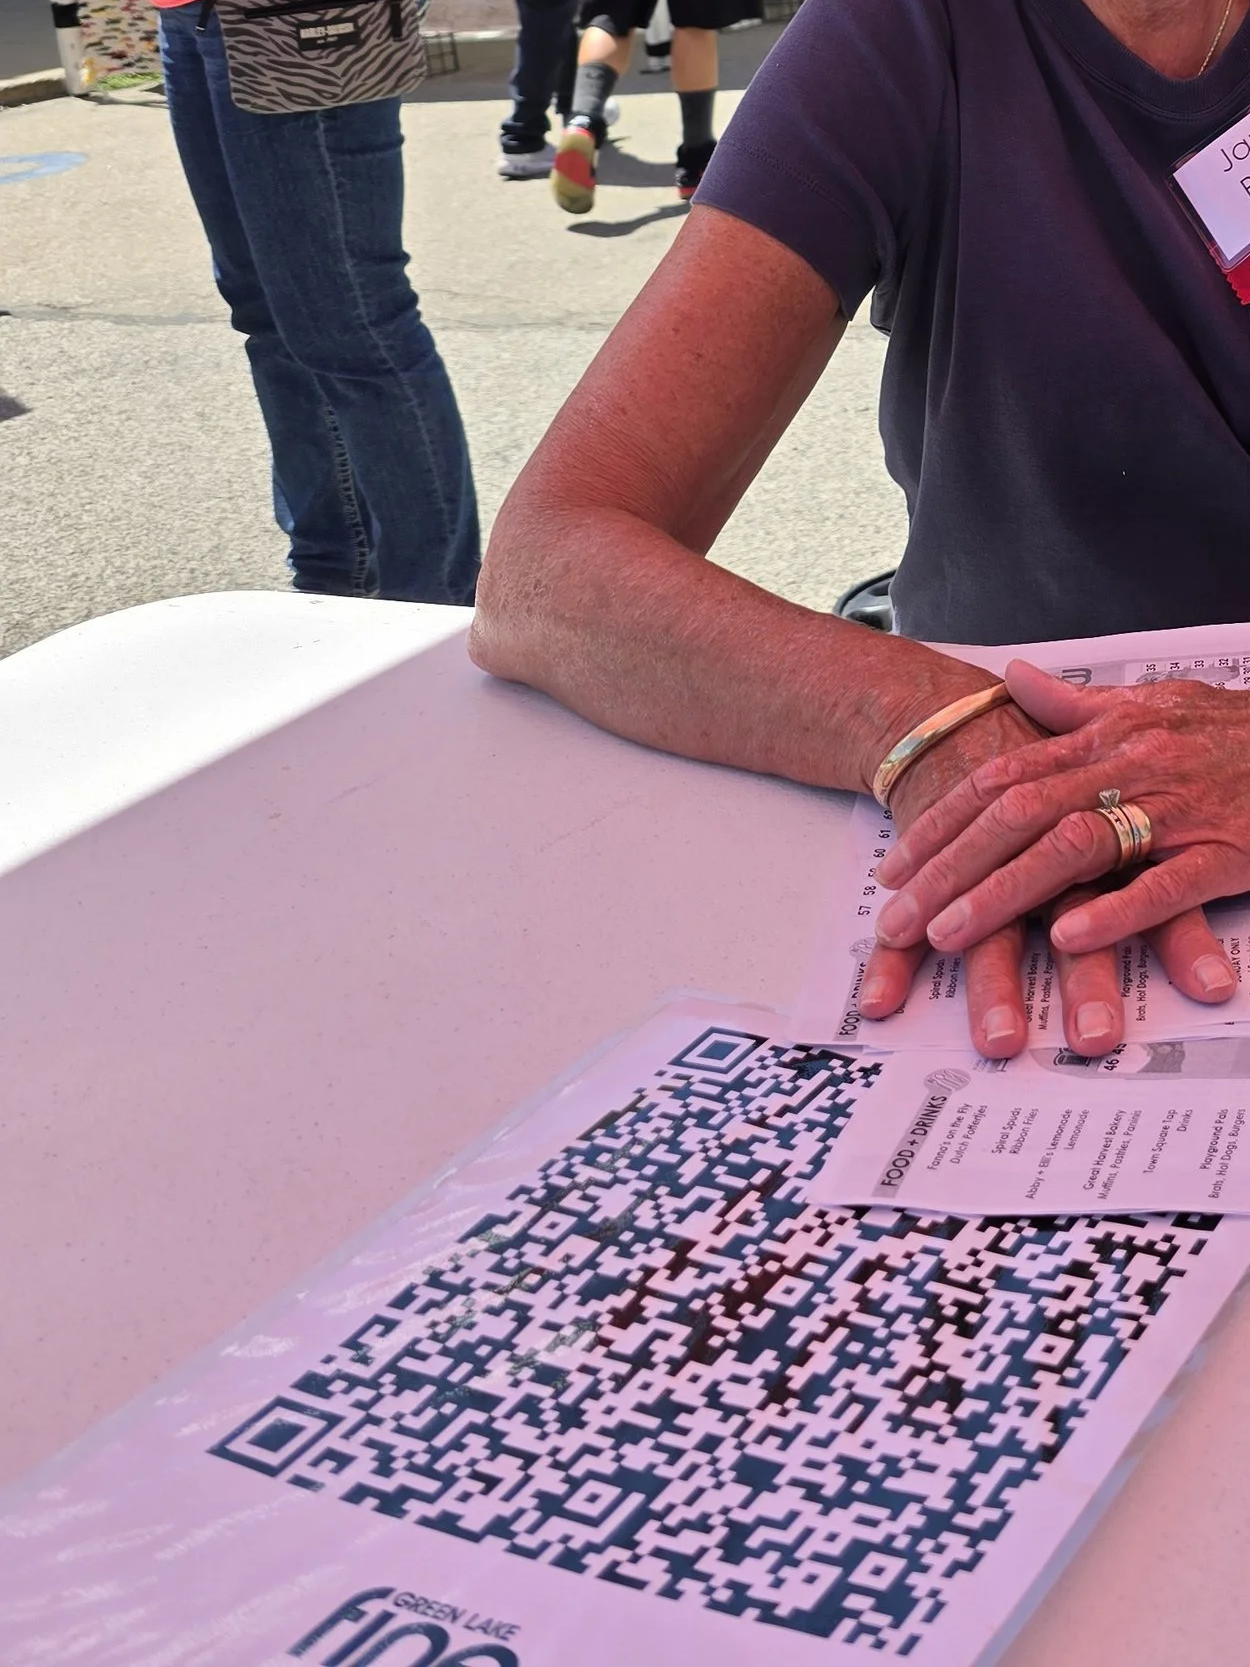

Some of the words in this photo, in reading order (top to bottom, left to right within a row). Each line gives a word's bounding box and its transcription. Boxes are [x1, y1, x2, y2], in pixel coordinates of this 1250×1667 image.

[1145, 663, 1157, 672] 35
[1169, 662, 1181, 670] 34
[1194, 660, 1205, 668] 33
[1218, 658, 1229, 666] 32
[883, 809, 893, 820] 62
[878, 829, 891, 839] 61
[873, 848, 886, 858] 60
[863, 885, 877, 896] 58
[857, 905, 872, 915] 57
[1137, 944, 1150, 968] Burgers
[1230, 937, 1240, 955] ONLY
[932, 958, 946, 980] Spuds
[949, 957, 961, 973] Fries
[1027, 953, 1041, 976] Bakery
[945, 973, 958, 998] Ribbon
[1040, 975, 1053, 1003] Pastries,
[1121, 960, 1133, 997] Playground
[1136, 969, 1149, 989] Dogs,
[928, 980, 942, 1000] Spiral
[1025, 977, 1036, 1003] Harvest
[1136, 990, 1146, 1002] Hot
[839, 1009, 861, 1036] FOOD
[1038, 1004, 1050, 1031] Muffins,
[1136, 1003, 1147, 1021] Brats,
[1103, 1059, 1120, 1071] 46
[957, 1103, 972, 1114] Fly
[1162, 1109, 1178, 1124] Tap
[949, 1116, 964, 1128] the
[991, 1131, 1010, 1154] Spiral
[1002, 1107, 1022, 1131] Spuds
[1009, 1127, 1031, 1155] Ribbon
[1023, 1108, 1039, 1125] Fries
[1064, 1109, 1090, 1150] Lemonade
[1105, 1109, 1127, 1136] Bakery
[1176, 1109, 1193, 1132] Drinks
[1228, 1109, 1246, 1137] Burgers
[881, 1149, 915, 1187] FOOD
[910, 1095, 947, 1136] DRINKS
[945, 1129, 957, 1140] on
[950, 1141, 969, 1164] Dutch
[962, 1104, 987, 1139] Poffertjes
[1151, 1125, 1170, 1152] Square
[1200, 1126, 1223, 1170] Playground
[1215, 1108, 1228, 1124] Pals
[927, 1141, 950, 1171] Fanna's
[1025, 1177, 1045, 1199] Abby
[1045, 1109, 1073, 1150] Lemonade
[1092, 1137, 1115, 1166] Harvest
[1097, 1171, 1120, 1200] Muffins,
[1109, 1138, 1133, 1169] Pastries,
[1123, 1110, 1142, 1136] Paninis
[1221, 1139, 1238, 1161] Dogs,
[1143, 1154, 1160, 1174] Town
[1216, 1162, 1229, 1176] Hot
[1083, 1167, 1102, 1190] Great
[1208, 1178, 1226, 1199] Brats,
[392, 1591, 467, 1624] GREEN
[463, 1613, 521, 1641] LAKE
